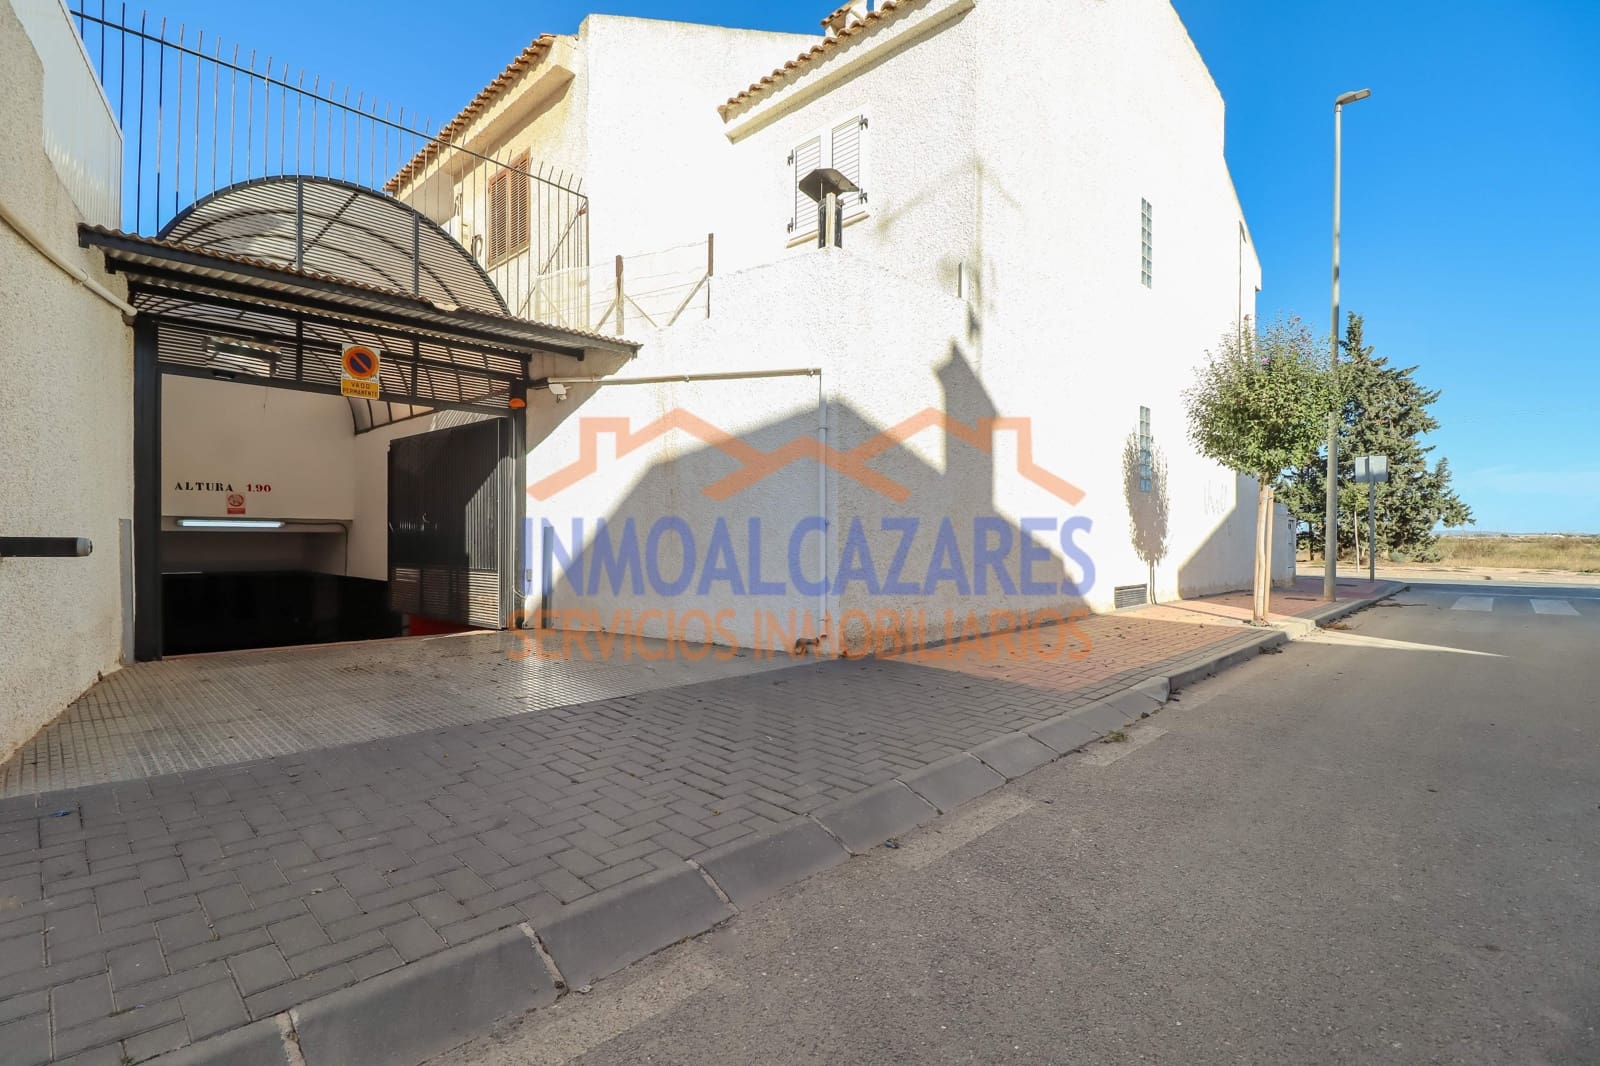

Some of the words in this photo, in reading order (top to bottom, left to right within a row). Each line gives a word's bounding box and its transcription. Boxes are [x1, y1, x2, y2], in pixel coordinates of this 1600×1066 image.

[343, 387, 377, 397] PERMANENTE
[174, 481, 234, 492] ALTURA
[245, 483, 272, 493] 1.90
